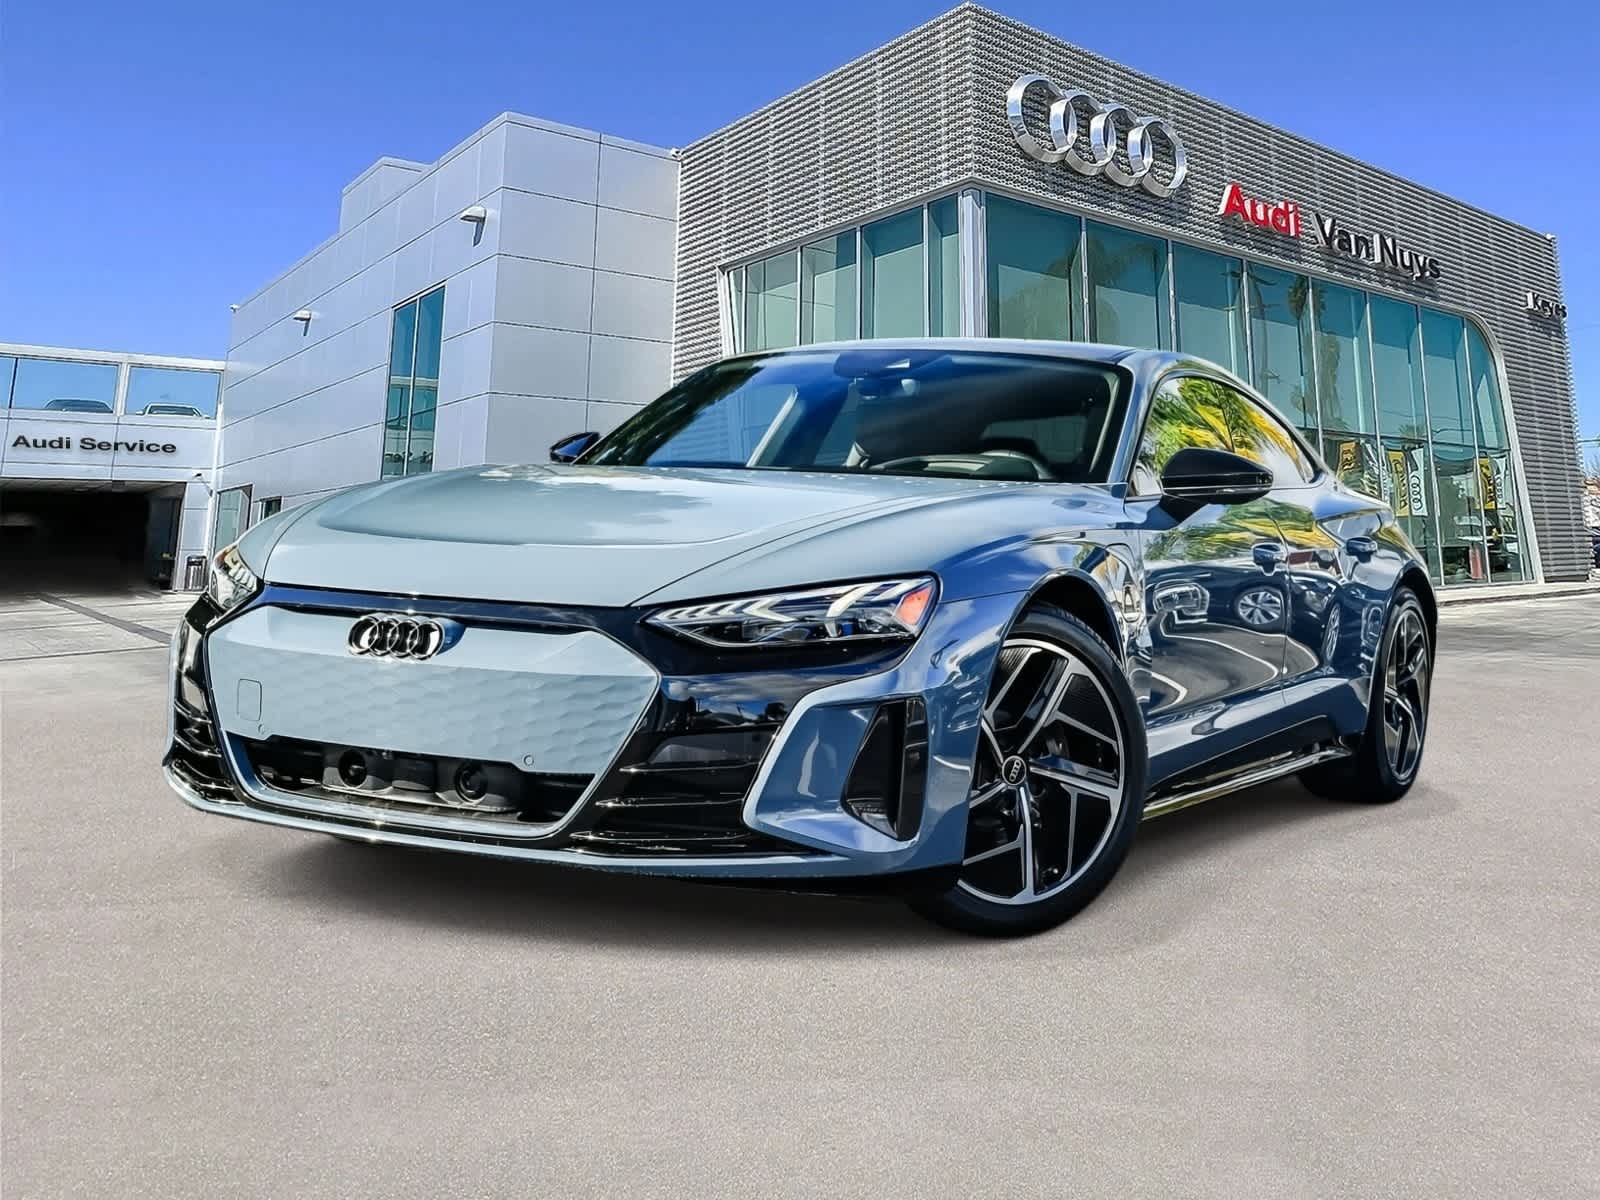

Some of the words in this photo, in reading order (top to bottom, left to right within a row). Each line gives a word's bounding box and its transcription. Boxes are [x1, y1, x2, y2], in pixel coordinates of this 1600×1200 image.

[1218, 182, 1302, 238] Audi
[1312, 213, 1370, 259] Van
[1373, 232, 1441, 280] Nuys
[1527, 292, 1568, 318] Keyes
[12, 435, 72, 449] Audi
[80, 437, 177, 454] Service
